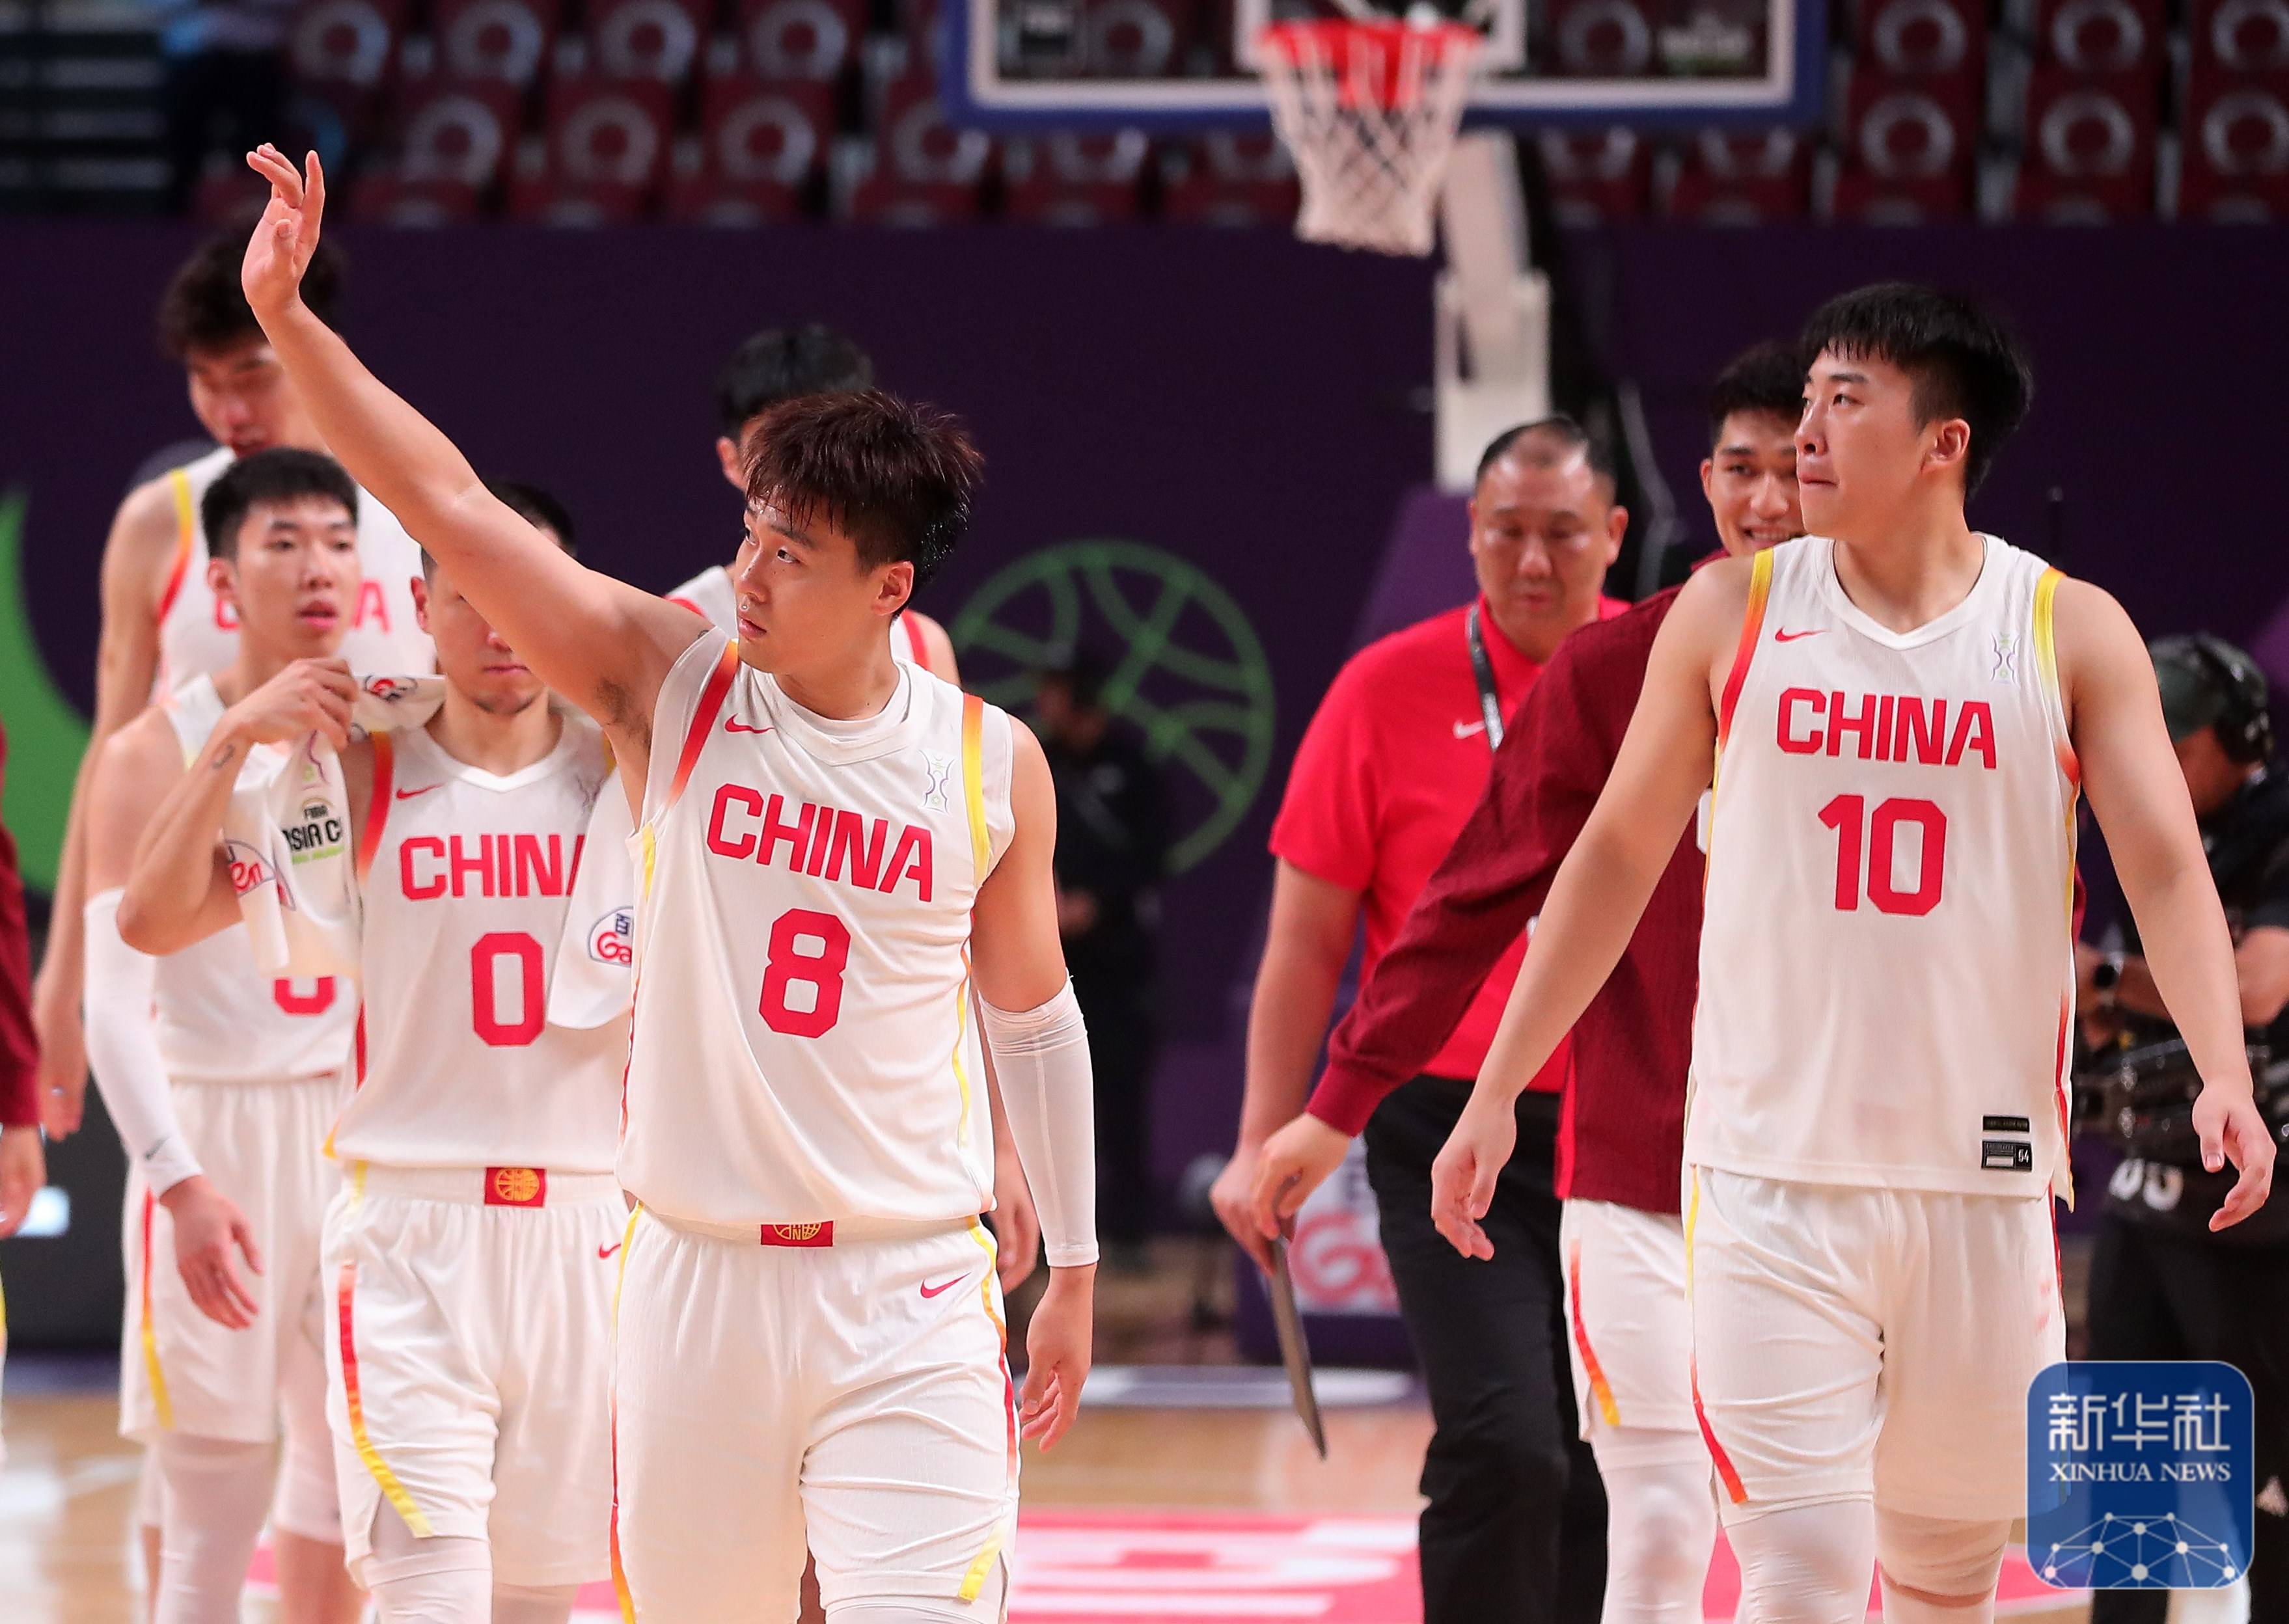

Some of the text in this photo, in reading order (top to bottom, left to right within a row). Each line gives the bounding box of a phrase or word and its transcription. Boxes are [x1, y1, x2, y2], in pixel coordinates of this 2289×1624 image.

[1776, 687, 1997, 770] CHINA
[707, 783, 933, 903] CHINA
[1818, 793, 1948, 917] 10
[471, 931, 546, 1048] 0
[759, 908, 852, 1039] 8
